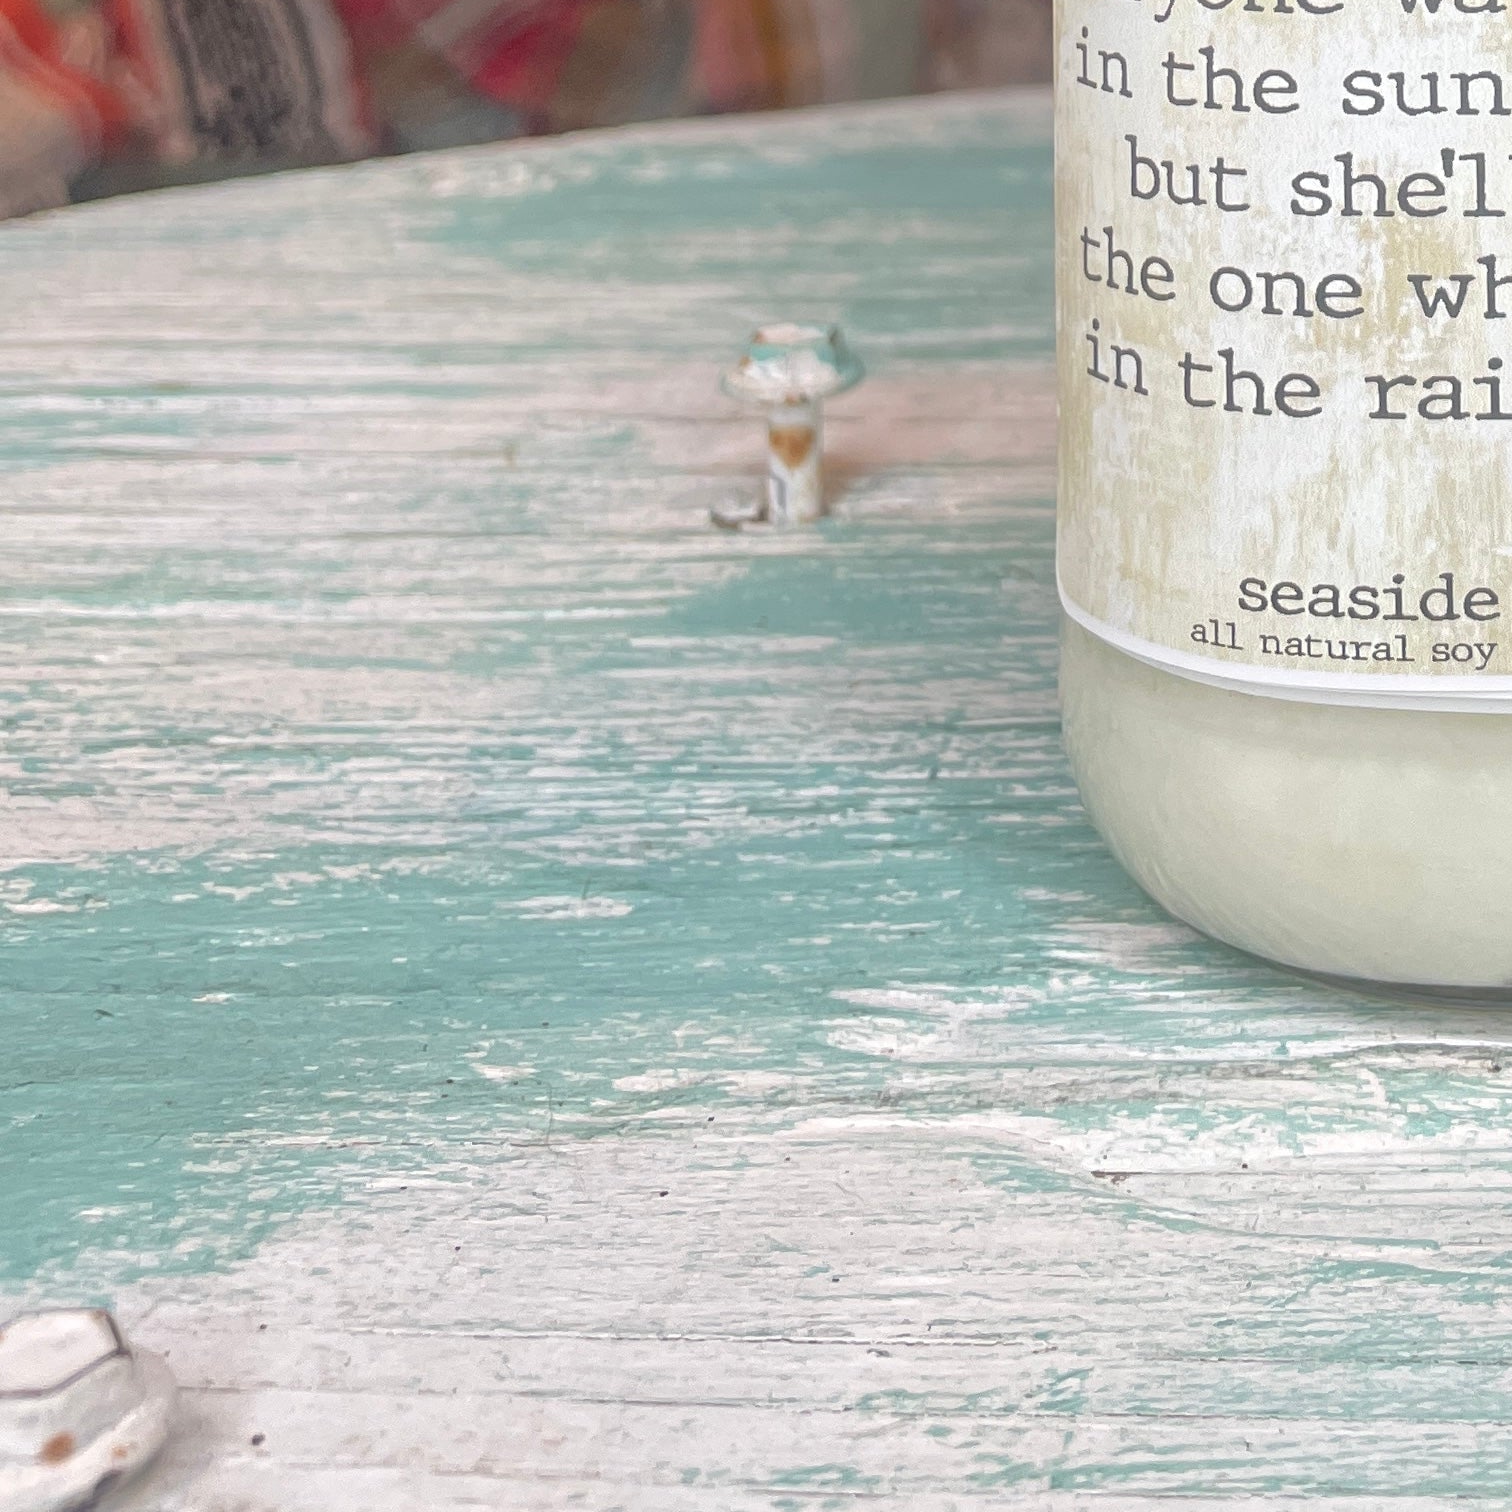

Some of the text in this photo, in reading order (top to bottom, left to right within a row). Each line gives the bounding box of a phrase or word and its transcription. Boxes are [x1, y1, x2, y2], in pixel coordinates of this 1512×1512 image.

[1076, 26, 1133, 98] in
[1161, 45, 1299, 114] the
[1342, 70, 1512, 116] sun
[1124, 134, 1250, 212] but
[1080, 225, 1176, 301] the
[1209, 267, 1365, 319] one
[1085, 318, 1149, 396] in
[1177, 347, 1323, 418] the
[1238, 572, 1501, 622] seaside
[1190, 618, 1244, 651] all
[1259, 634, 1415, 662] natural
[1431, 642, 1498, 671] soy
